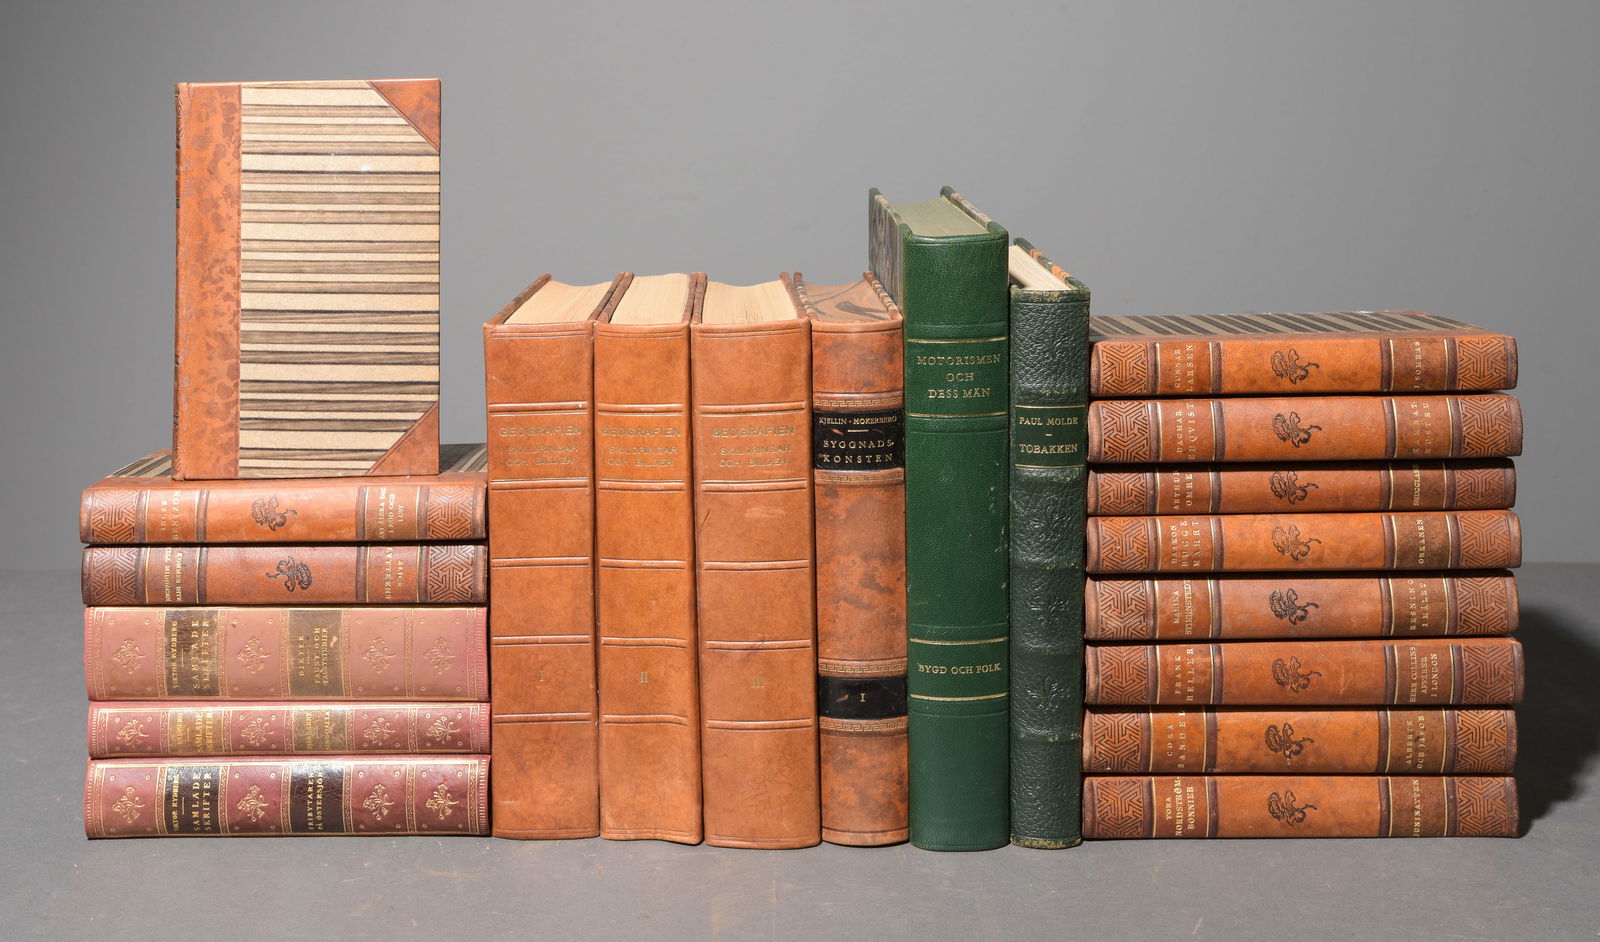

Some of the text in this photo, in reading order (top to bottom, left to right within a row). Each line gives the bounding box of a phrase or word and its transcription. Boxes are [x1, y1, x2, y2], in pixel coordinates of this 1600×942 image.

[917, 354, 1000, 366] MOTORISMEN
[945, 372, 974, 382] OCH
[1186, 344, 1194, 392] LARSEN
[928, 387, 991, 399] DESS MÄN
[500, 425, 581, 437] GEOGRAFIEN
[601, 426, 681, 438] GEOGRAFIEN
[712, 425, 794, 438] GEOGRAFIEN
[818, 417, 847, 425] KJELLIN
[1019, 417, 1078, 425] PAUL MOLDE
[1176, 410, 1184, 453] DAGMAR
[1187, 402, 1198, 460] EDQVIST
[1422, 403, 1432, 454] HUSTRU
[823, 453, 893, 463] KONSTEN
[1020, 444, 1078, 454] TOBAKKEN
[1185, 473, 1193, 506] OMRE
[1170, 525, 1179, 564] HAAKON
[1180, 520, 1188, 567] BUGGE
[1192, 520, 1201, 567] MAHRT
[1416, 519, 1425, 564] ORKANEN
[1407, 579, 1416, 631] RESNING
[191, 620, 200, 689] SAMLADE
[917, 663, 947, 674] BYGD
[976, 663, 1001, 673] FOLK
[1431, 653, 1439, 690] LONDON
[1186, 648, 1195, 701] HELLER
[860, 693, 866, 702] I
[1417, 751, 1425, 769] OCH
[192, 773, 201, 831] SAMLADE
[203, 773, 211, 831] SKRIFTER
[1187, 786, 1195, 830] BONNIER
[316, 822, 323, 830] PÅ
